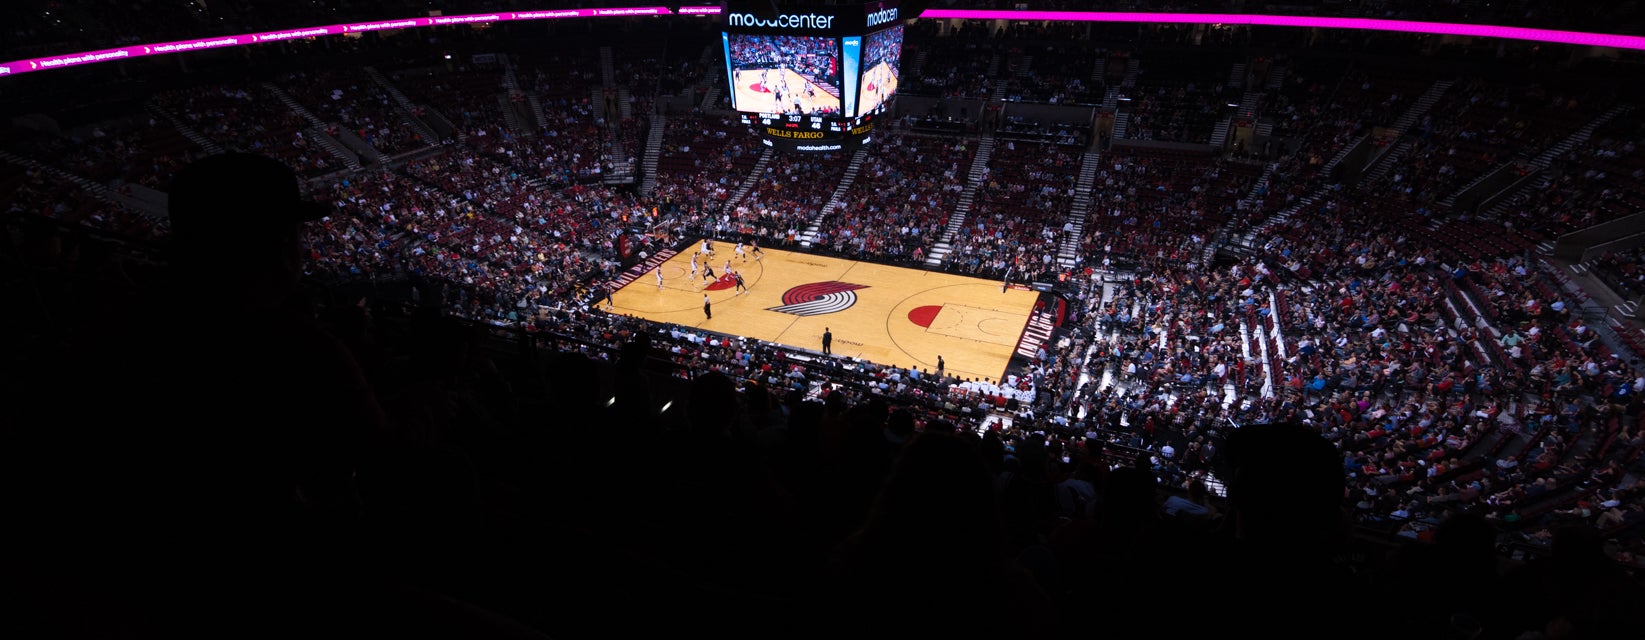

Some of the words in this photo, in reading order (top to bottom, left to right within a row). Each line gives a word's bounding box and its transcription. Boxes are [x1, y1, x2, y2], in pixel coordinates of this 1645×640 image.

[474, 14, 499, 22] personality
[391, 20, 417, 28] personality
[259, 33, 277, 41] Health
[302, 28, 328, 36] personality
[206, 38, 237, 48] personality
[40, 58, 63, 67] Health
[63, 57, 81, 65] plans
[81, 54, 95, 62] with
[95, 50, 128, 60] personality
[766, 127, 792, 138] WELLS
[793, 131, 824, 139] FARGO
